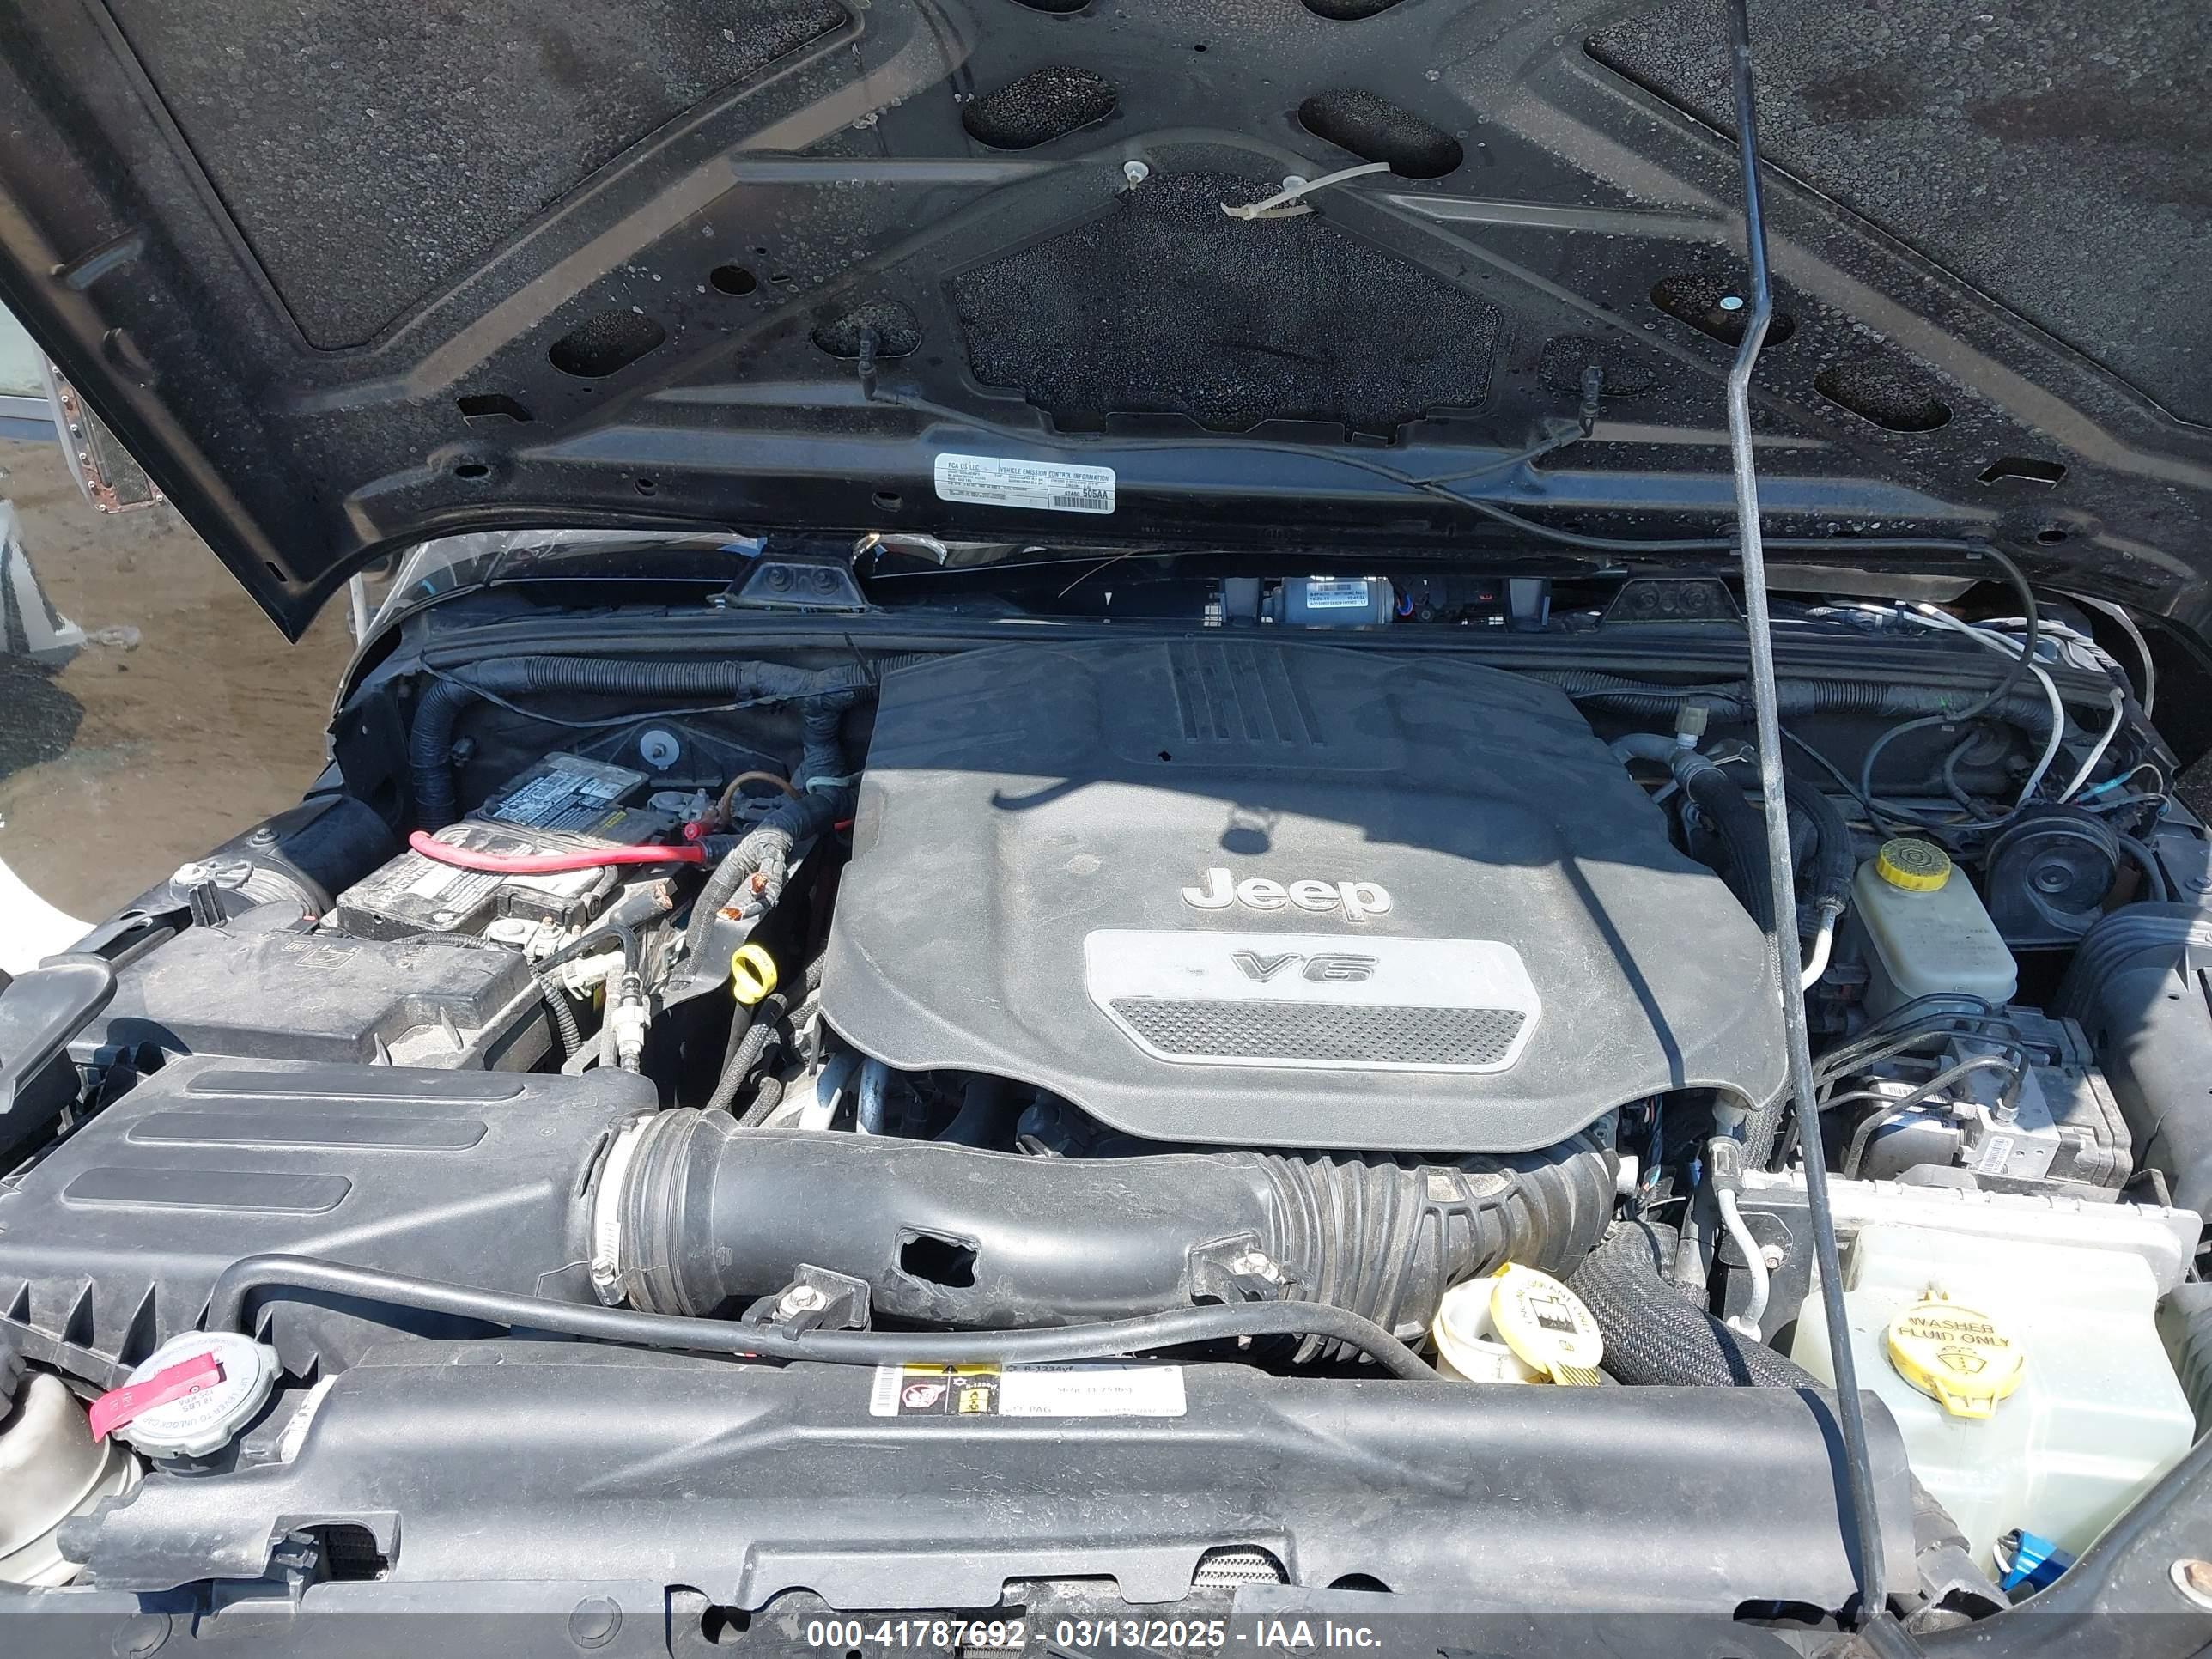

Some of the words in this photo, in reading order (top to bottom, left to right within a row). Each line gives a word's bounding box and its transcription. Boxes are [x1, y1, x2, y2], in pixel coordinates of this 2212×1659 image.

[1000, 466, 1022, 475] VEHICLE
[1022, 468, 1047, 477] EMISSION
[1048, 470, 1071, 479] CONTROL
[1073, 472, 1109, 482] INFORMATION
[1082, 488, 1109, 499] 505AA
[1182, 867, 1393, 923] Jeep
[1230, 951, 1378, 982] V6
[1908, 1316, 1995, 1334] WASHER
[1898, 1326, 1954, 1341] FLUID
[1960, 1333, 2009, 1347] ONLY
[181, 1400, 202, 1413] LBS
